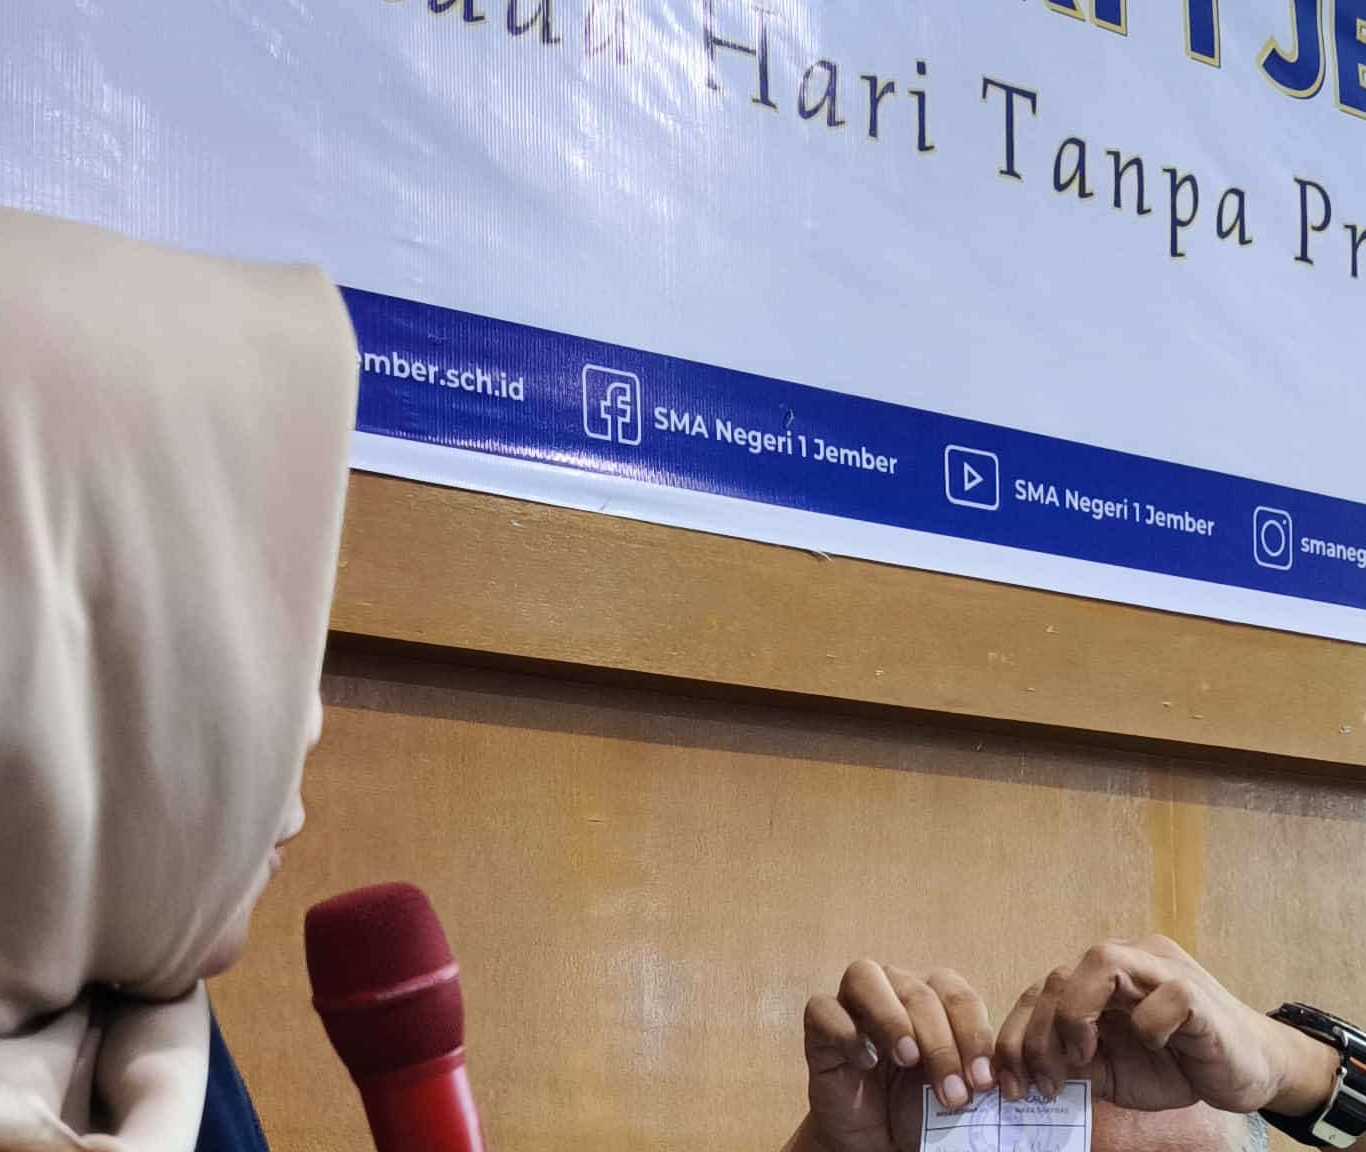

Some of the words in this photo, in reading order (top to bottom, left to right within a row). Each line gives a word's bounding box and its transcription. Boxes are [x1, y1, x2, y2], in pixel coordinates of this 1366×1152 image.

[701, 0, 935, 152] Hari
[982, 75, 1253, 258] Tanpa
[653, 406, 709, 438] SMA
[715, 418, 793, 454] Negeri
[798, 435, 808, 458] 1
[813, 438, 898, 475] Jember
[1014, 479, 1060, 508] SMA
[1065, 488, 1128, 520] Negeri
[1133, 502, 1141, 523] 1
[1145, 505, 1215, 537] Jember
